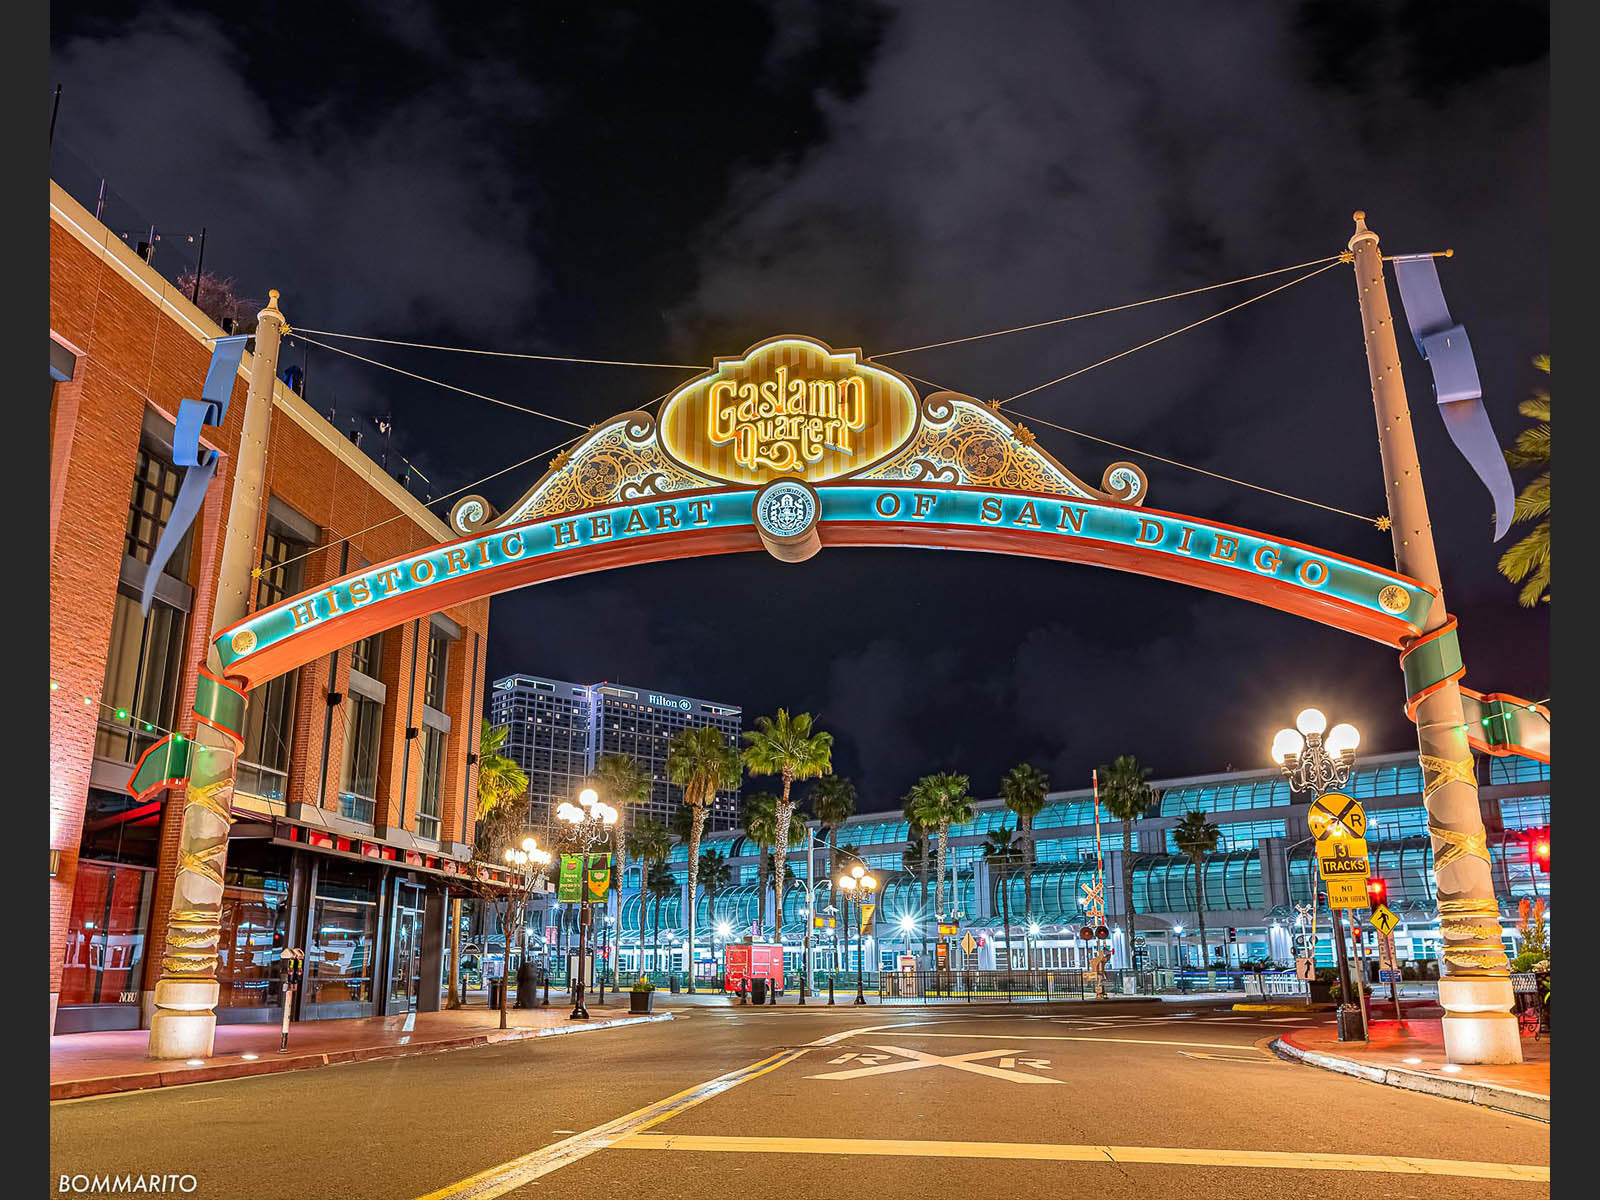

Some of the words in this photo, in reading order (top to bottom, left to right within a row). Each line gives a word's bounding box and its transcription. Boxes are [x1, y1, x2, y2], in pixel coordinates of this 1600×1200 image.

[708, 366, 865, 455] Gaslamp
[734, 413, 843, 472] Quarter
[288, 532, 526, 628] HISTORIC
[552, 498, 713, 551] HEART
[875, 491, 938, 519] OF
[980, 497, 1089, 535] SAN
[1134, 517, 1330, 588] DIEGO
[649, 694, 677, 708] Hilton
[1350, 813, 1363, 828] R
[1338, 844, 1347, 857] 3
[1323, 859, 1366, 873] TRACKS
[1341, 885, 1353, 893] NO
[1331, 895, 1349, 904] TRAIN
